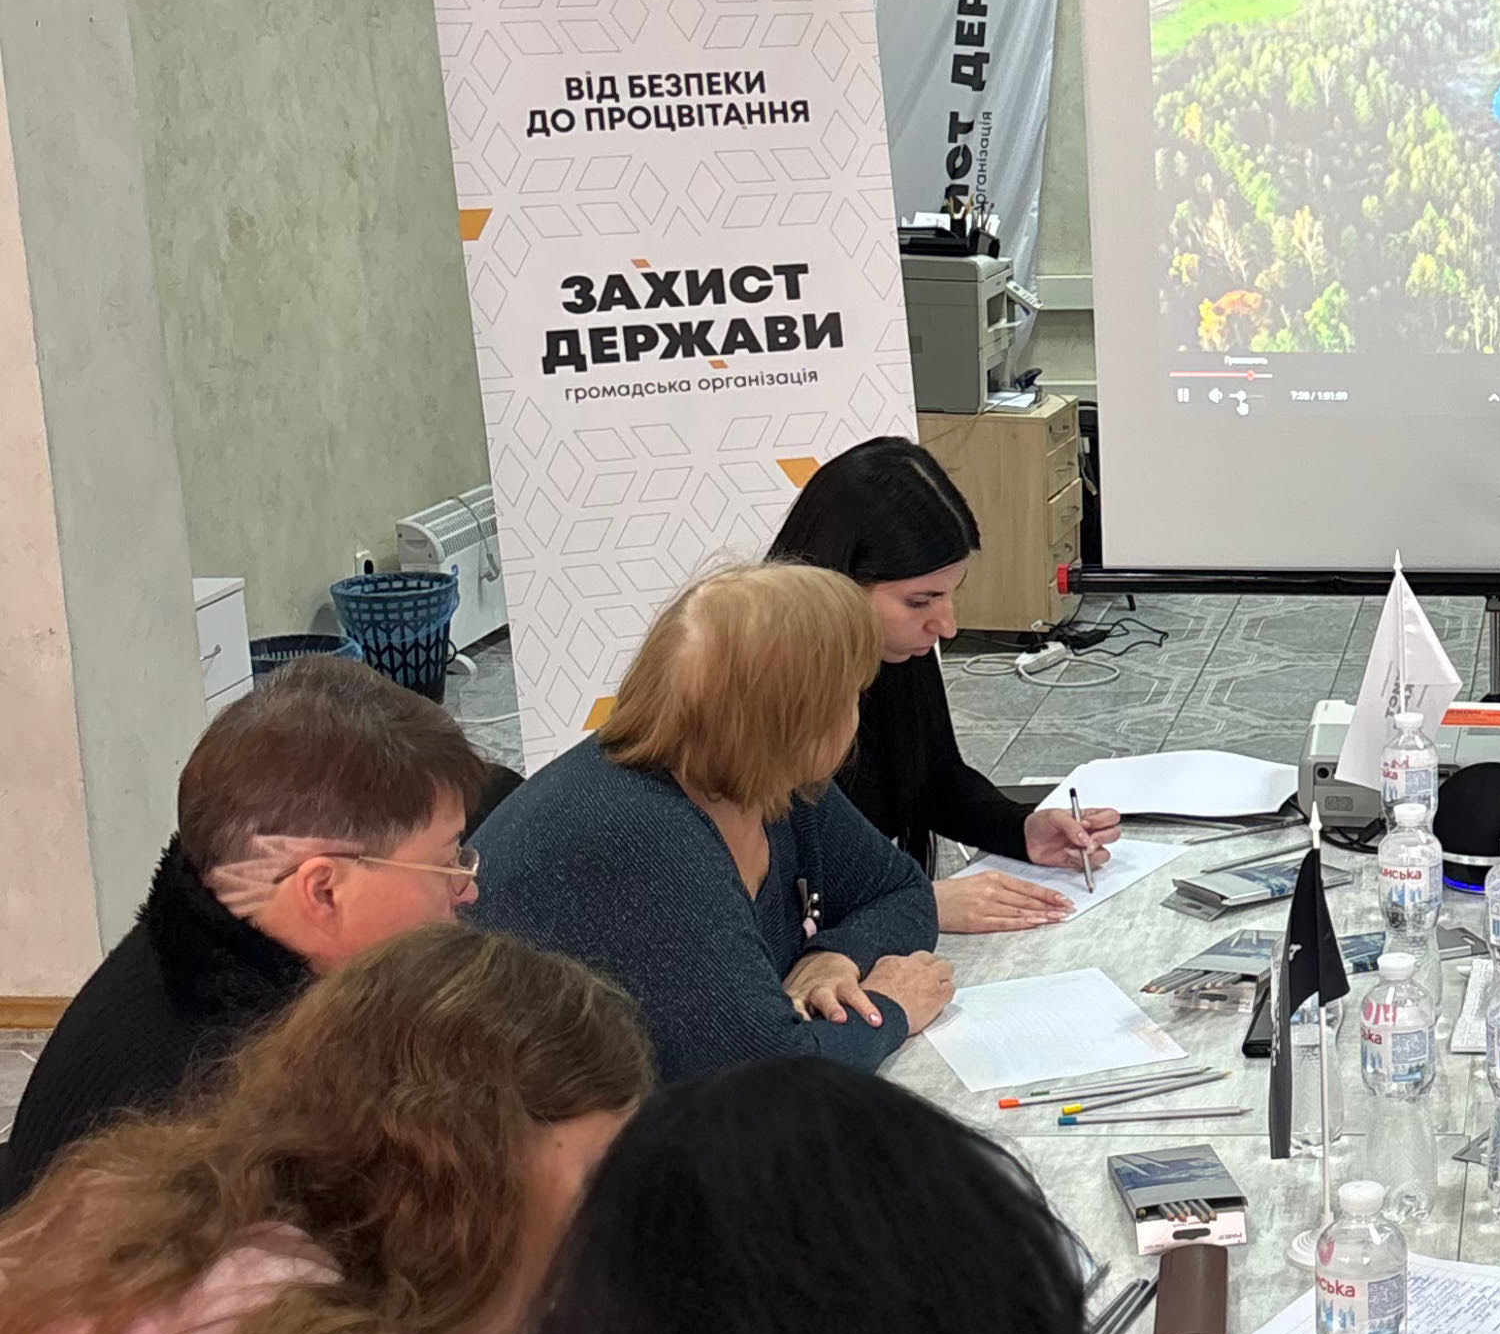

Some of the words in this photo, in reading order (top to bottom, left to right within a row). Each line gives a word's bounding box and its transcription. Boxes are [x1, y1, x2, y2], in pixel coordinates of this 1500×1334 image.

[565, 71, 620, 103] ВІД
[627, 70, 766, 99] БЕЗПЕКИ
[526, 107, 576, 137] ДО
[585, 99, 811, 133] ПРОЦВІТАННЯ
[561, 263, 810, 315] ЗАХИСТ
[541, 311, 845, 375] ДЕРЖАВИ
[565, 378, 691, 404] громадська
[697, 367, 819, 395] організація
